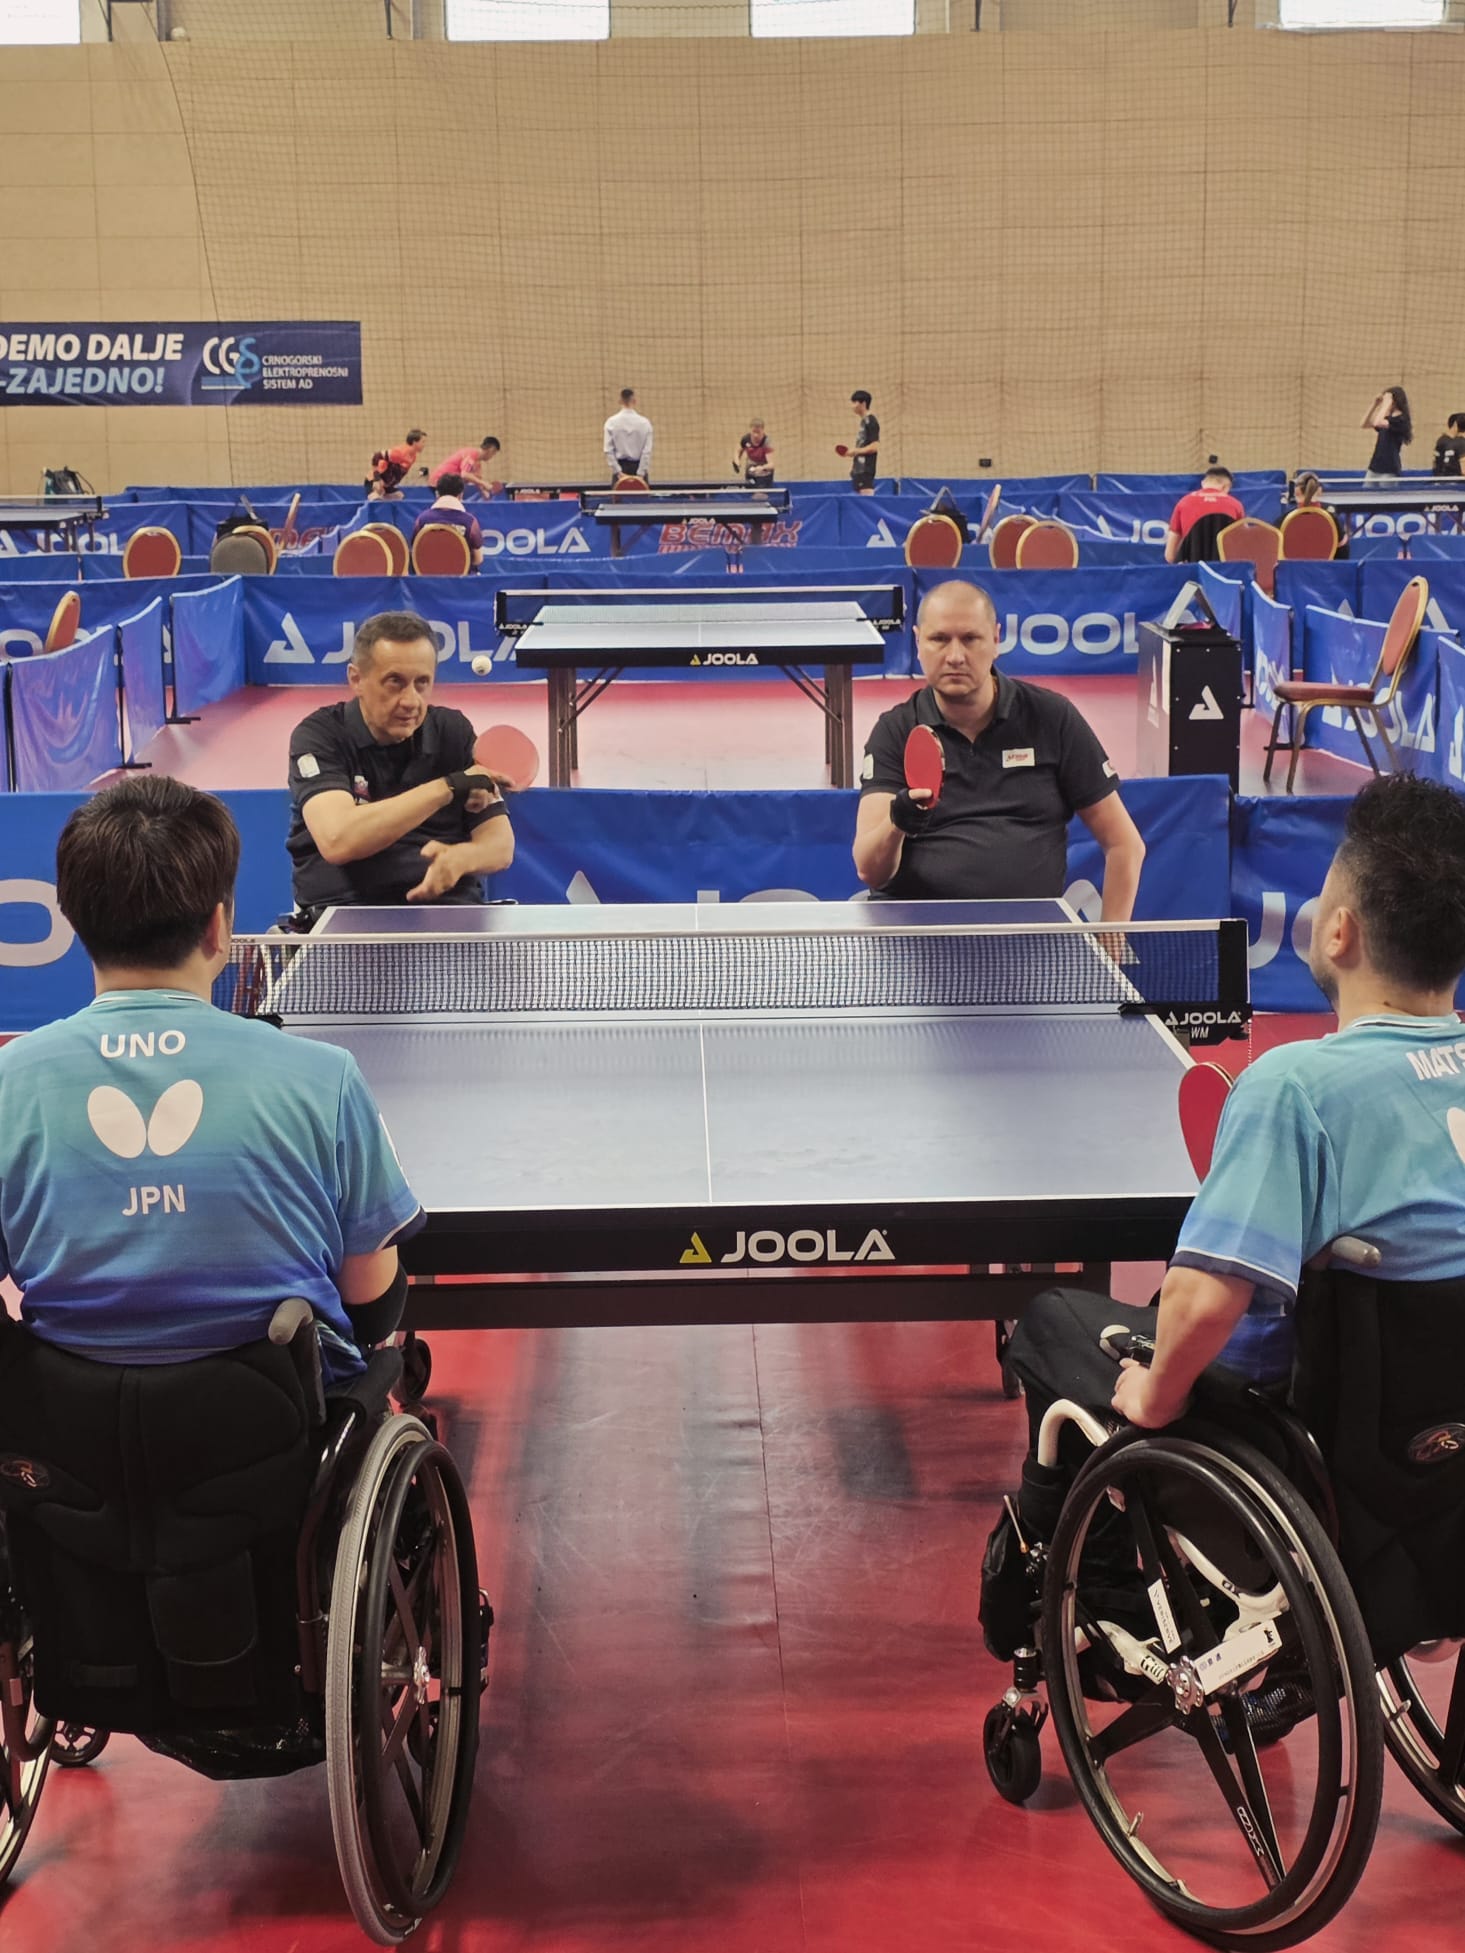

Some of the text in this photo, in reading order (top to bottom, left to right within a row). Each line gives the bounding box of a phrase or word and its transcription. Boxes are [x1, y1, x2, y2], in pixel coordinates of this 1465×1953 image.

[86, 333, 184, 361] DALJE
[262, 355, 322, 366] CRNOGORSKI
[262, 367, 349, 378] ELEKTROPRENOSNI
[263, 379, 313, 390] SISTEM AD
[702, 653, 759, 665] JOOLA
[1180, 1011, 1242, 1026] JOOLA
[1191, 1026, 1209, 1039] WM
[101, 1030, 186, 1059] UNO
[122, 1184, 186, 1217] JPN
[720, 1228, 897, 1264] JOOLA
